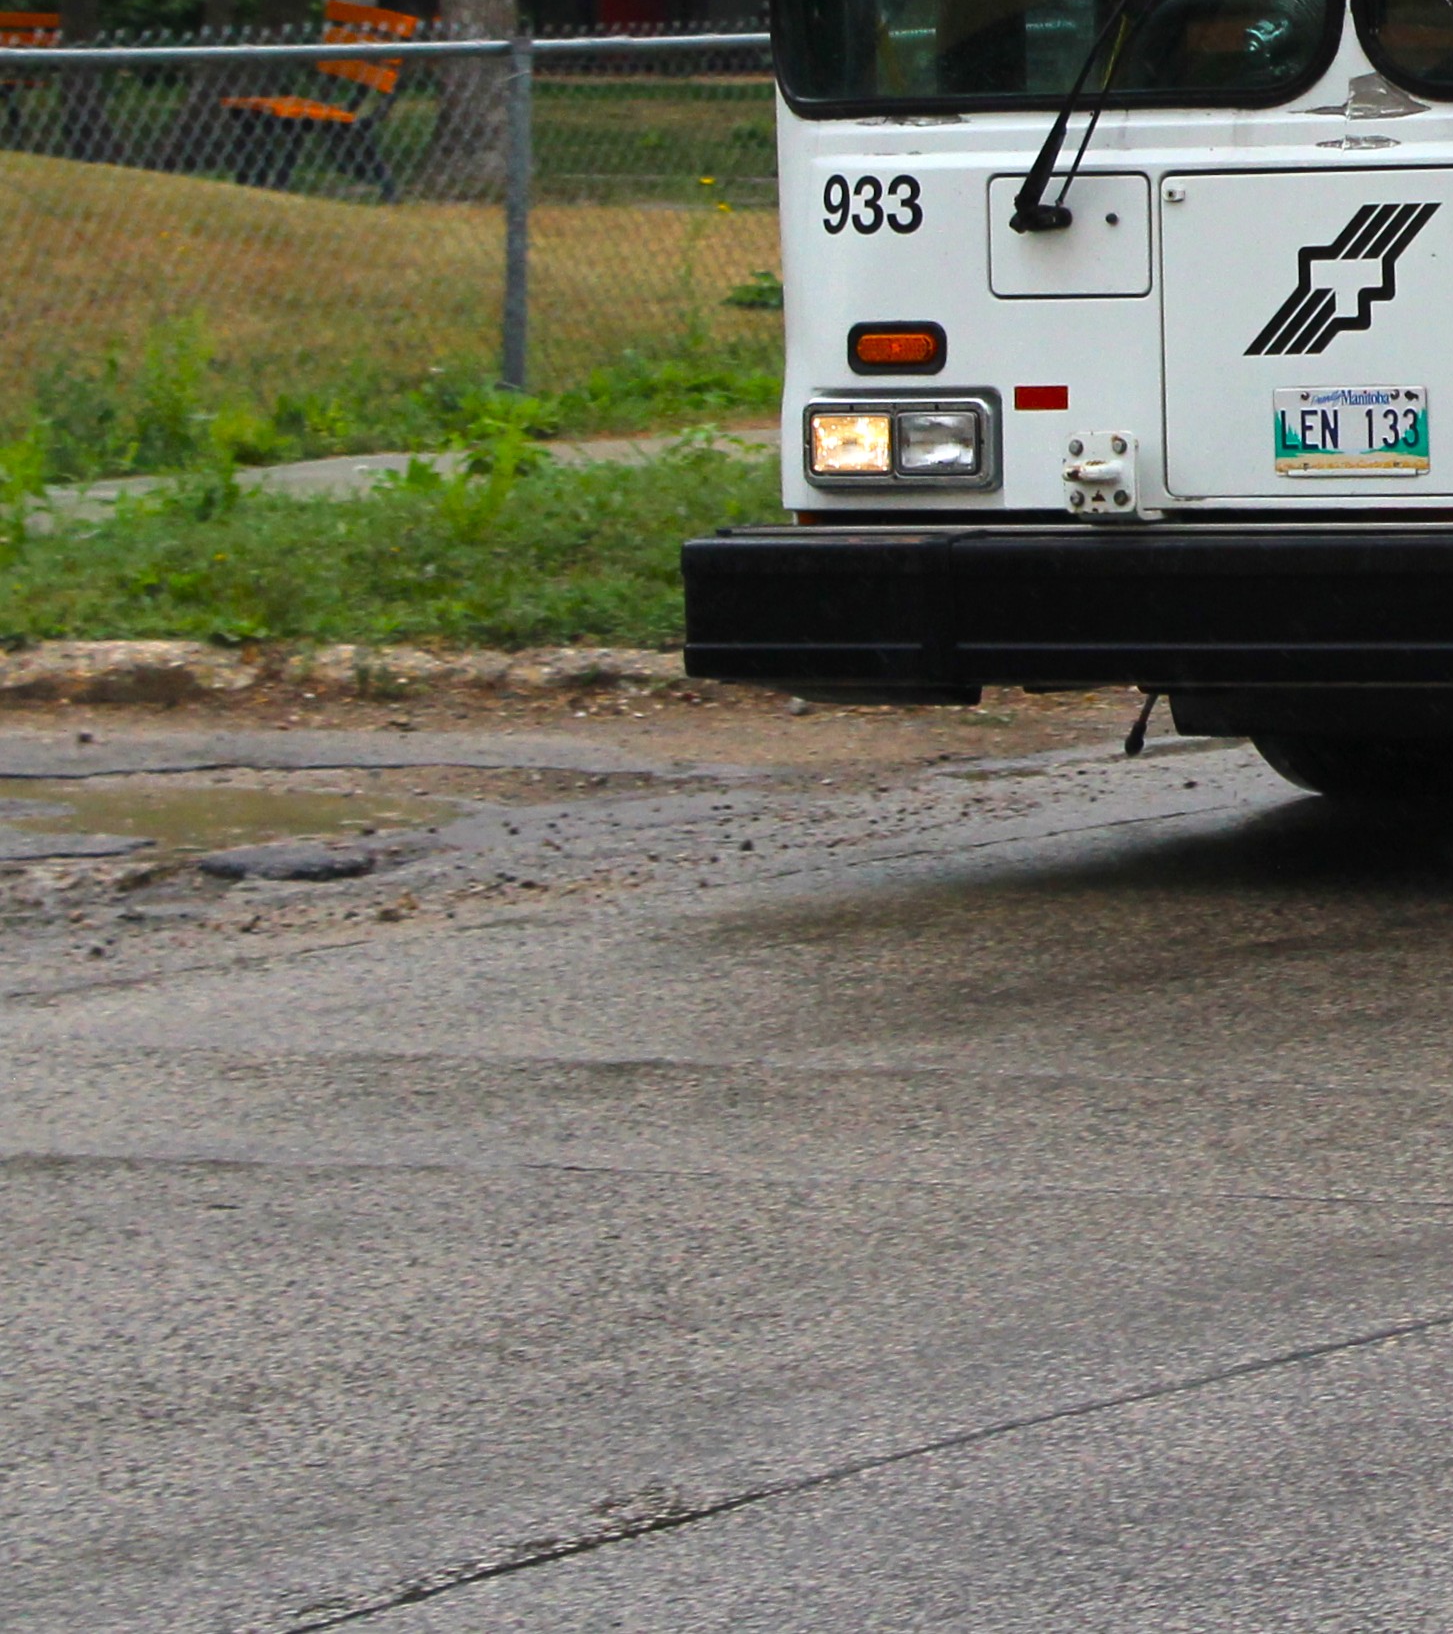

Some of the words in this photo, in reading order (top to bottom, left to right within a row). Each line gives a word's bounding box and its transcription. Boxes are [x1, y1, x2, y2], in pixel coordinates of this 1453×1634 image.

[823, 173, 924, 235] 933
[1341, 389, 1390, 406] Manitoba
[1281, 409, 1339, 450] LEN
[1365, 408, 1420, 449] 133
